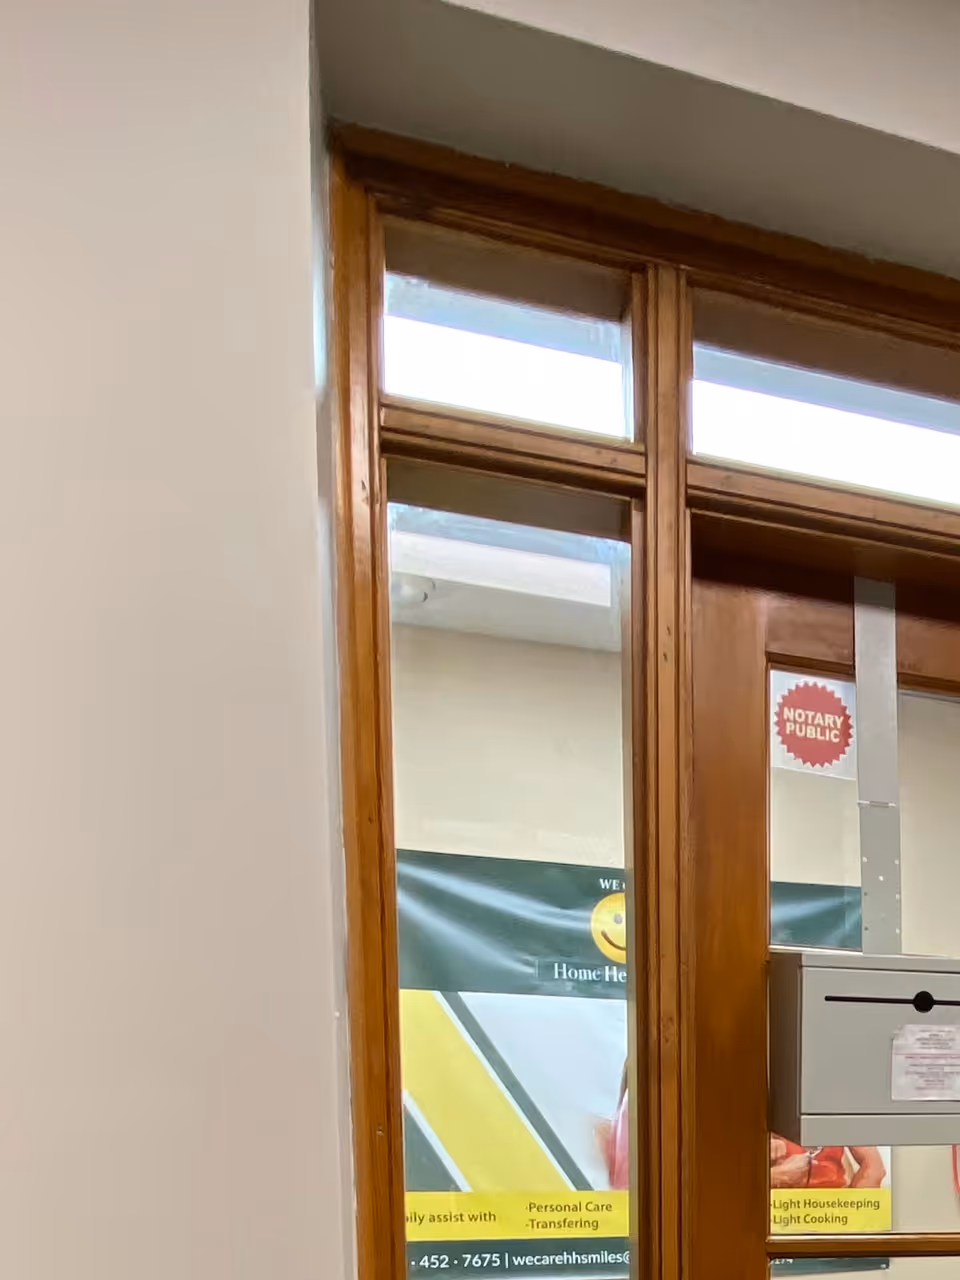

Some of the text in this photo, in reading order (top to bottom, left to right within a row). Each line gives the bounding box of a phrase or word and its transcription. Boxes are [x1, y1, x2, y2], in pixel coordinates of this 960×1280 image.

[783, 707, 844, 729] NOTARY
[786, 722, 840, 743] PUBLIC
[599, 878, 619, 890] WE
[554, 962, 601, 981] Home
[585, 1201, 613, 1212] Care
[803, 1198, 880, 1210] Housekeeping
[428, 1211, 465, 1224] assist
[468, 1211, 496, 1223] with
[803, 1213, 848, 1226] Cooking
[419, 1254, 450, 1268] 452
[462, 1253, 501, 1267] 7675
